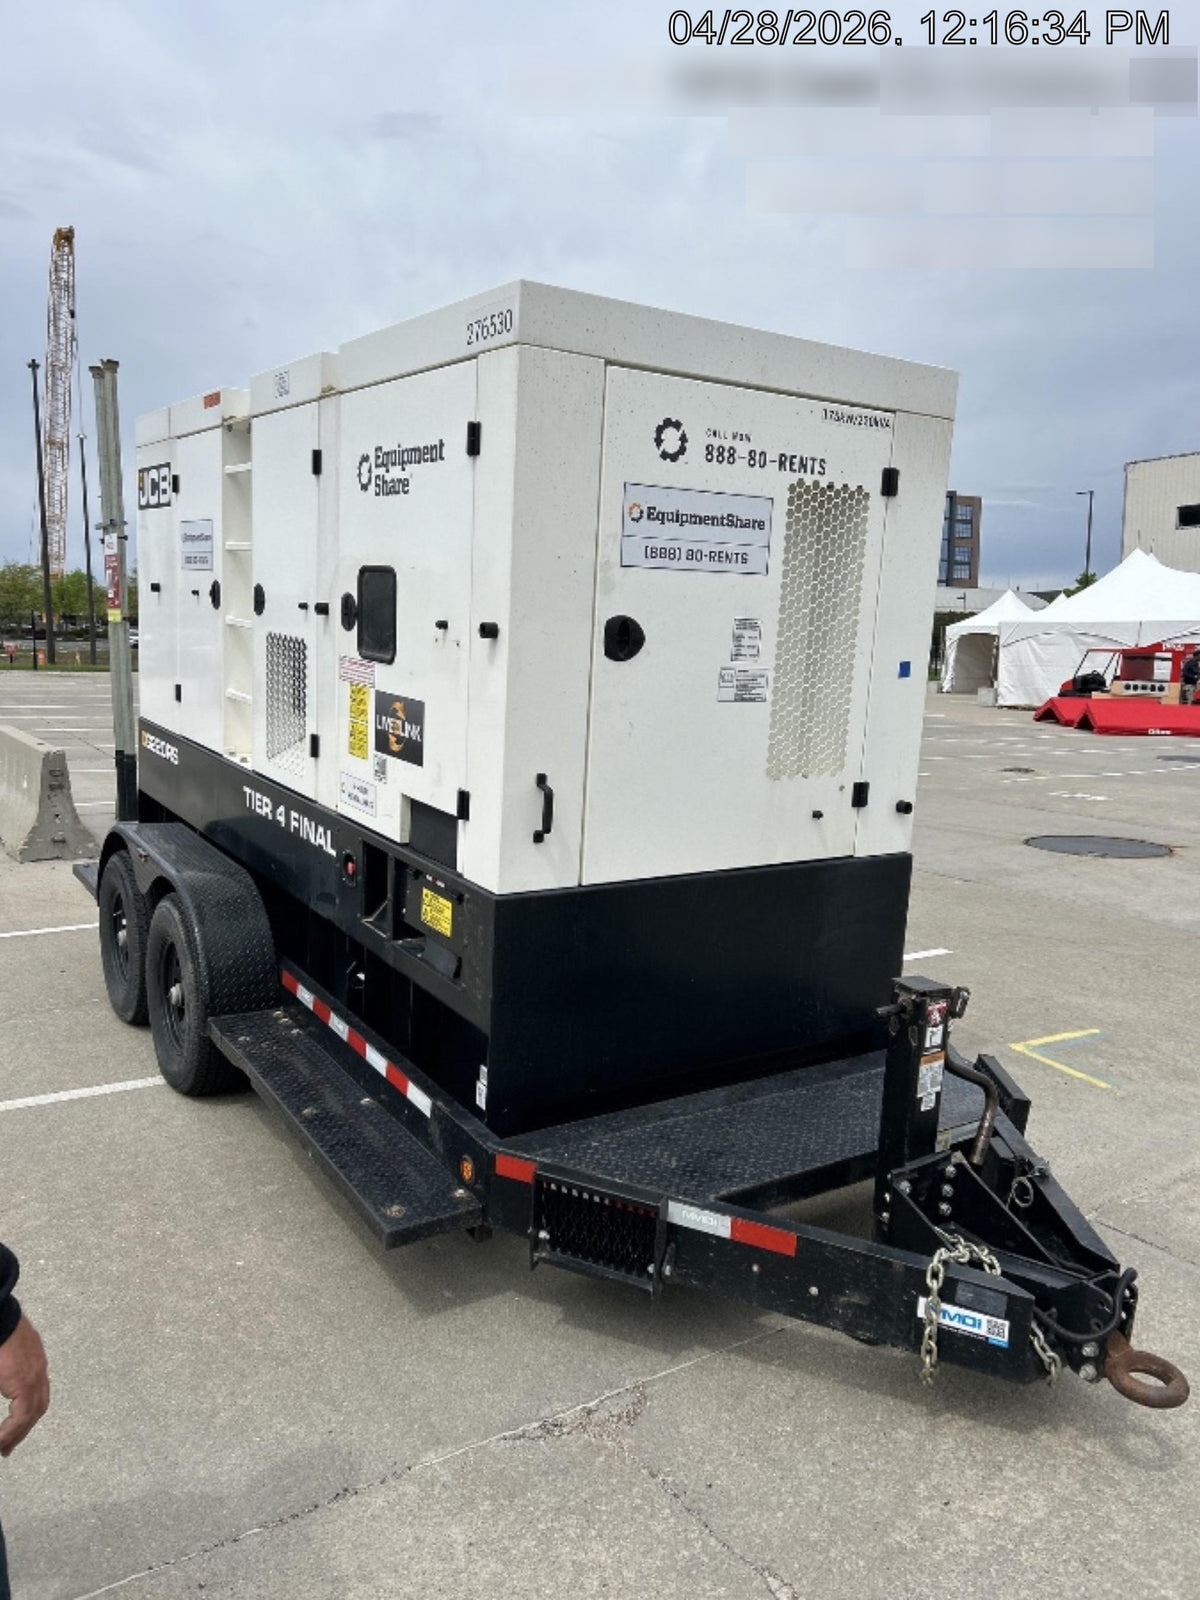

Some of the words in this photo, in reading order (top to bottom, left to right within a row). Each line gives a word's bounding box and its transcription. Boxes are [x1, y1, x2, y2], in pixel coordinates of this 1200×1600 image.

[466, 309, 513, 346] 276530
[374, 439, 445, 473] Equipment
[705, 444, 827, 476] 888-80-RENTS
[139, 465, 171, 506] JCB
[374, 474, 410, 497] Share
[646, 506, 766, 531] EquipmentShare
[686, 548, 750, 565] 80-RENTS
[243, 785, 273, 820] TIER
[276, 805, 286, 828] 4
[290, 810, 337, 858] FINAL
